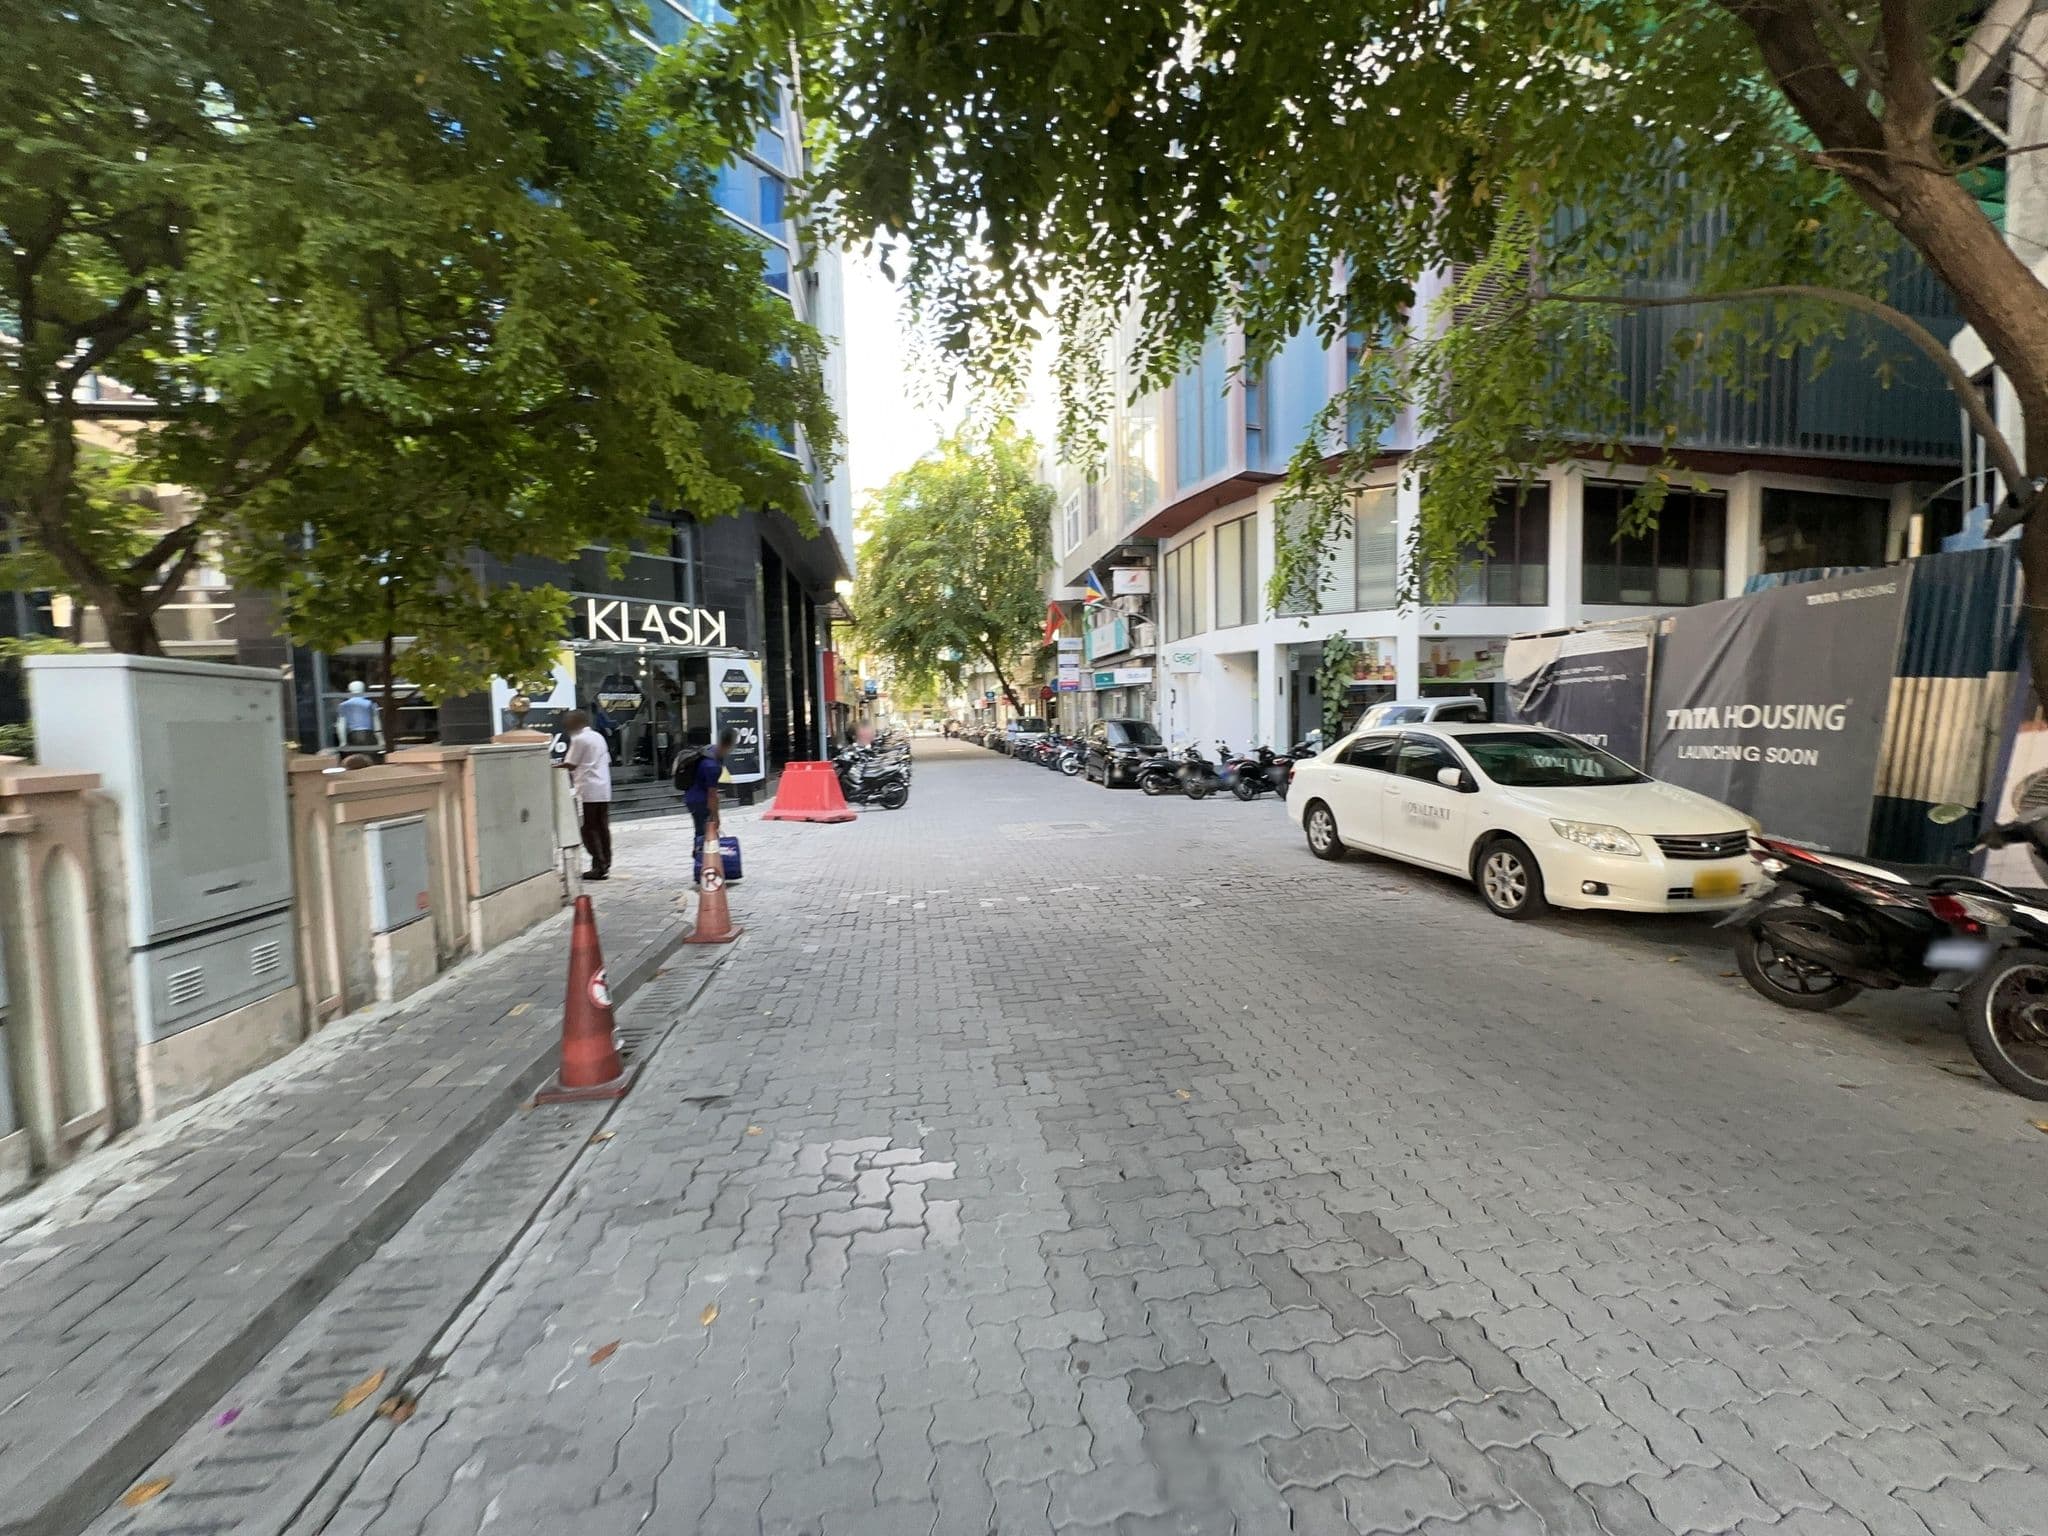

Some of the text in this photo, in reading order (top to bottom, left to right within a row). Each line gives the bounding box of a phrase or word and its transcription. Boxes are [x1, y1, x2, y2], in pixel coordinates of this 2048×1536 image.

[587, 598, 727, 647] KLASIK
[1666, 704, 1847, 731] TATA HOUSING
[1764, 747, 1820, 766] SOON
